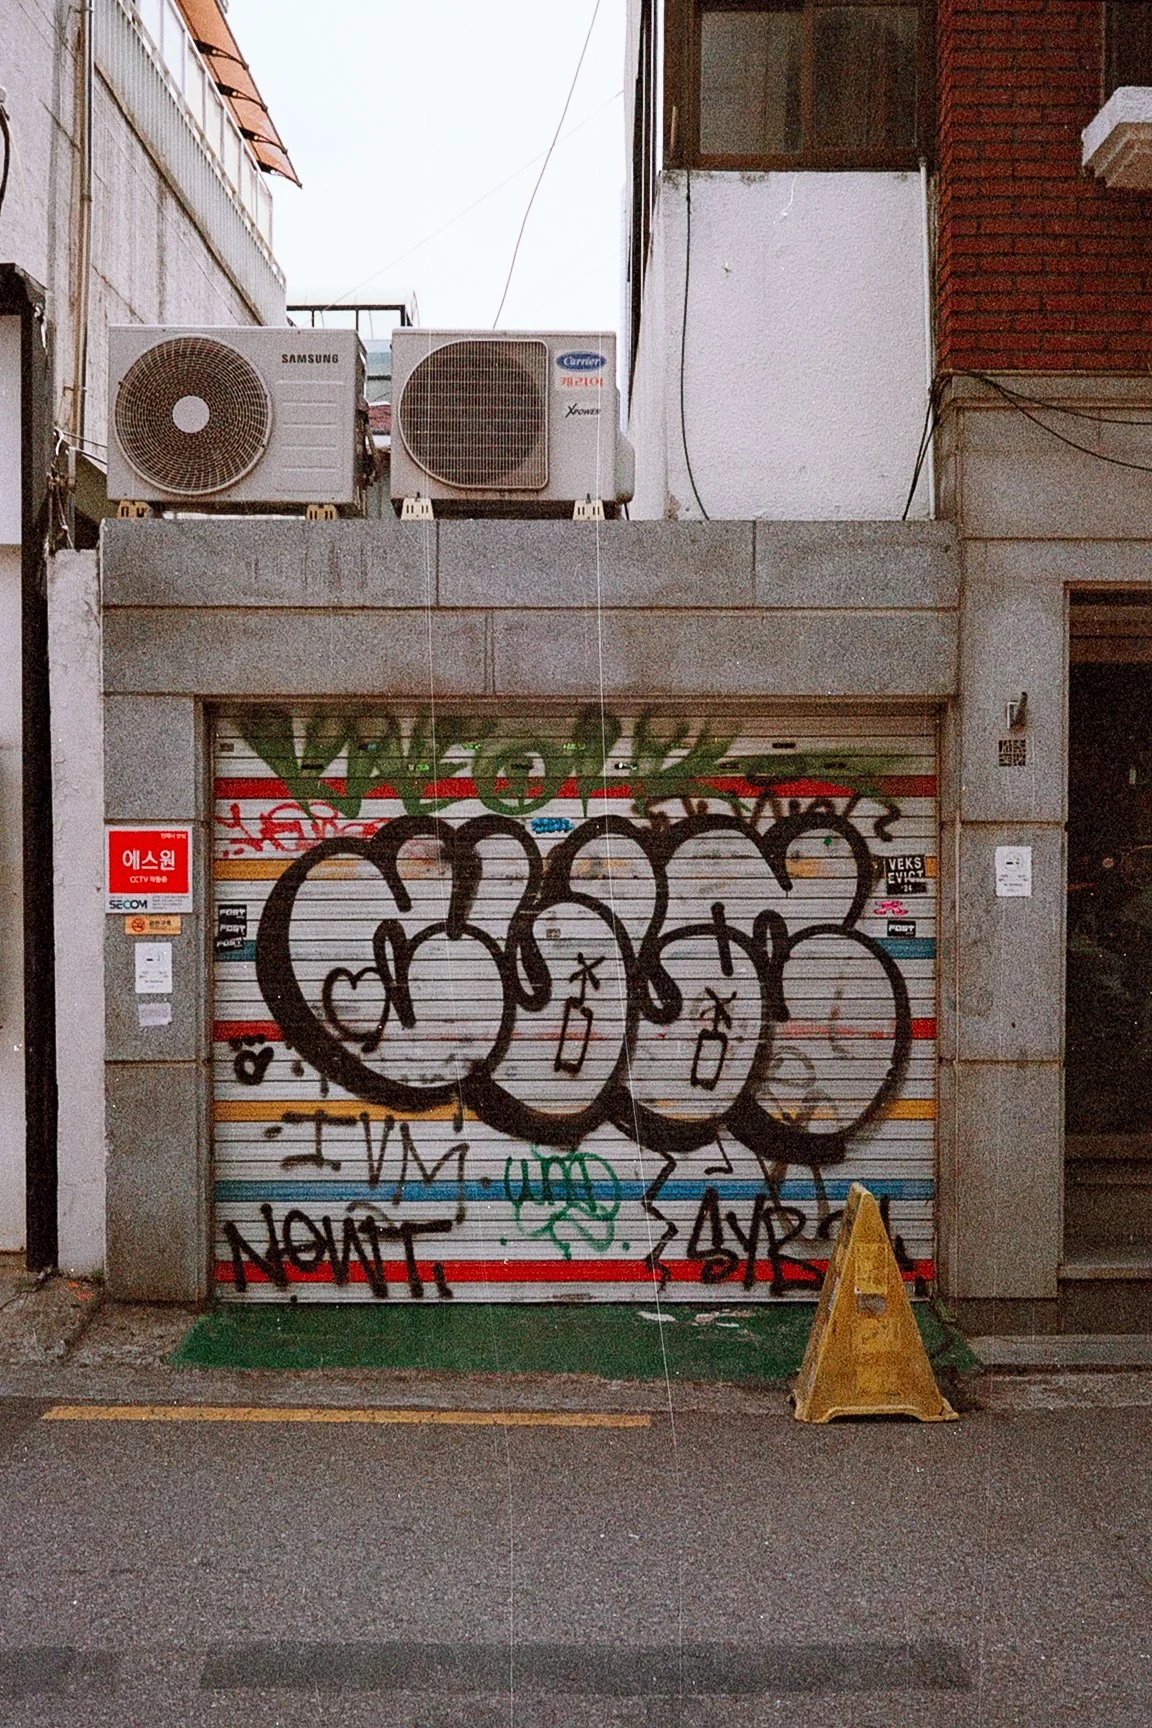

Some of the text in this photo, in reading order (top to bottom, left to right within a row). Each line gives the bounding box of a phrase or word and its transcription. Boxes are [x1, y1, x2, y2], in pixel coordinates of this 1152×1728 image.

[281, 353, 339, 364] SAMSUNG
[563, 356, 601, 367] Carrier
[560, 376, 603, 388] 캐리어
[122, 849, 176, 871] 에스원
[889, 857, 922, 871] VEKS
[129, 875, 149, 884] CCTV
[887, 870, 924, 884] EVICT
[109, 899, 148, 910] SECOM
